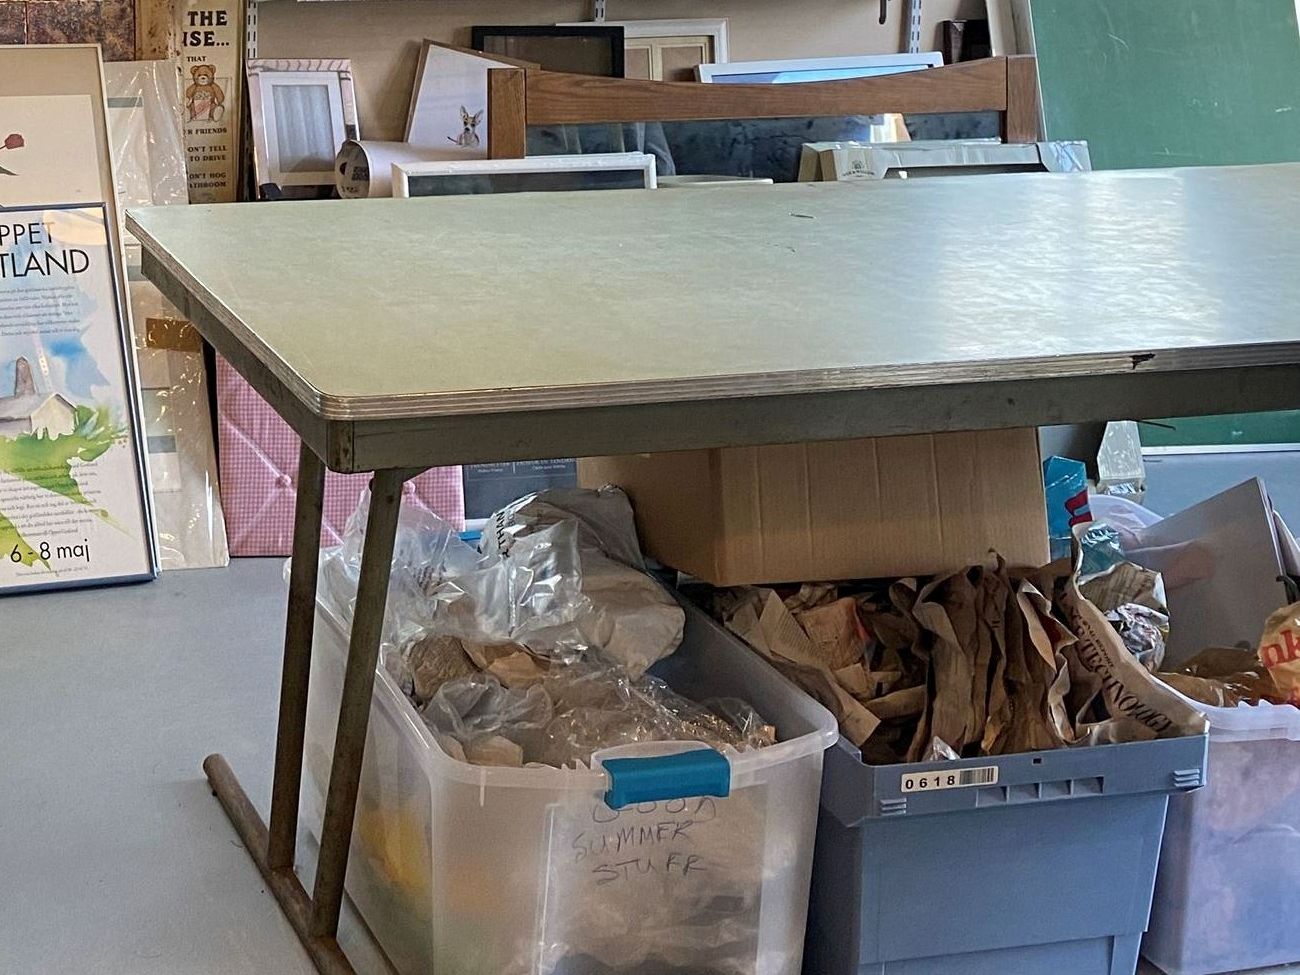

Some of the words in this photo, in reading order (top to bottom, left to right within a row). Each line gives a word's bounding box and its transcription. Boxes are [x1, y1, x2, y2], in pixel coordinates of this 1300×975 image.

[187, 10, 228, 26] THE
[195, 127, 228, 135] FRIENDS
[10, 544, 22, 563] 6
[39, 541, 51, 560] 8
[56, 538, 90, 562] maj
[1080, 641, 1174, 734] TECHNOLOGY
[905, 775, 955, 790] 0618
[571, 819, 695, 864] SUMMER
